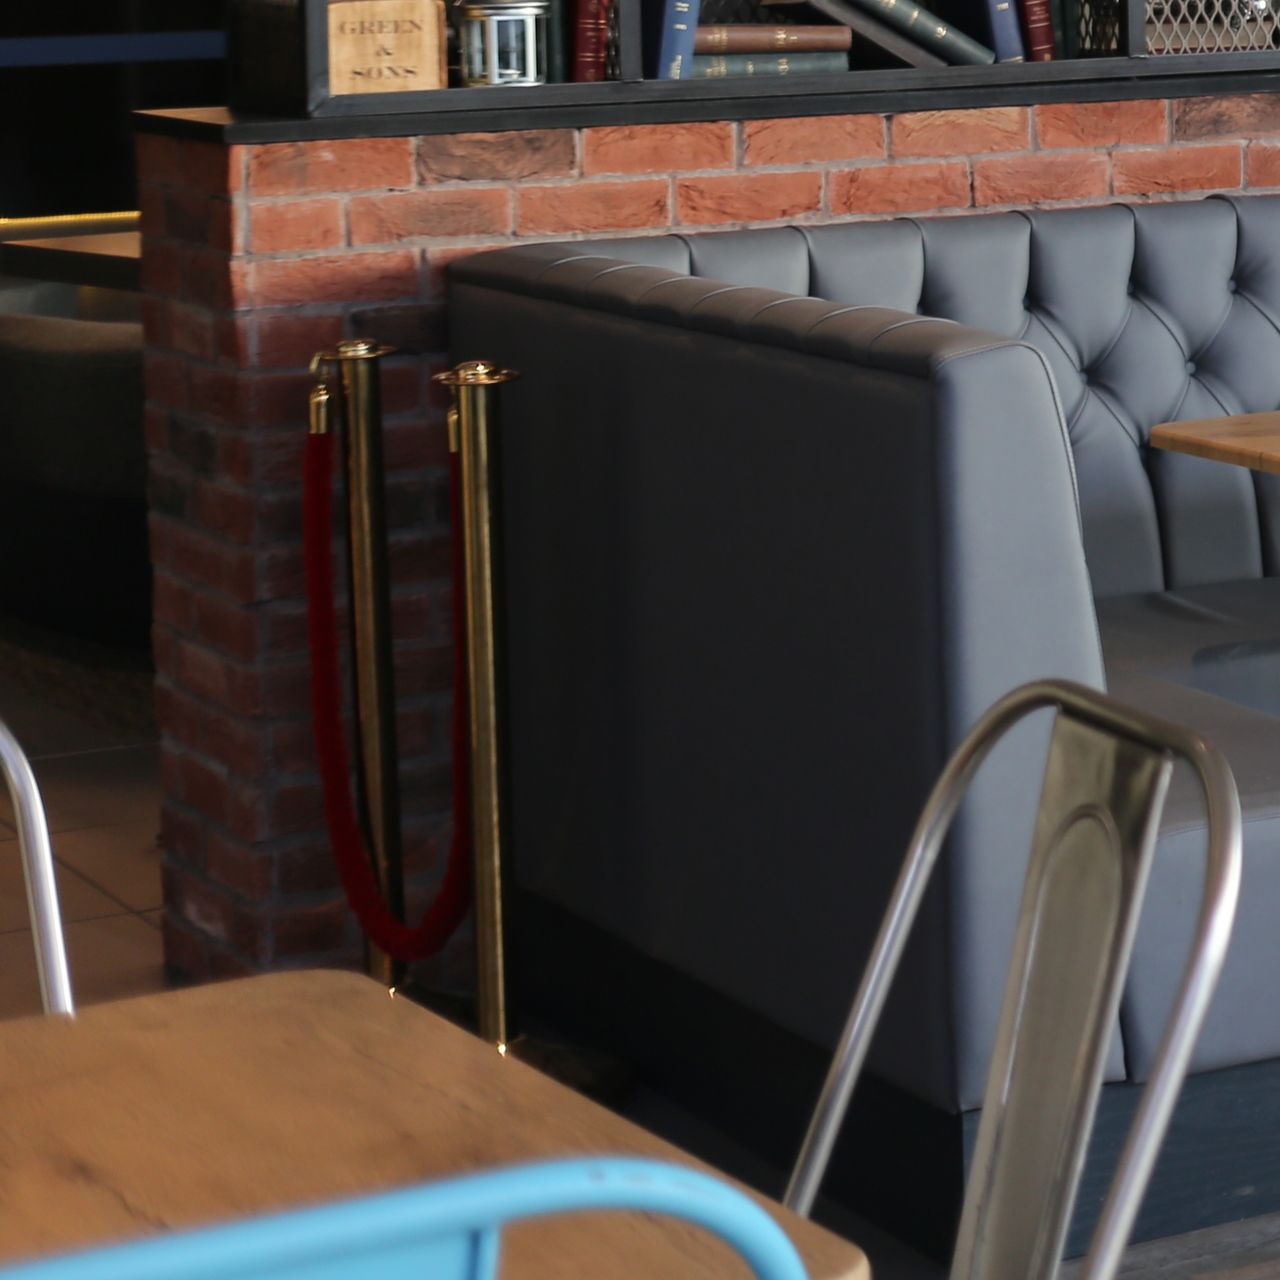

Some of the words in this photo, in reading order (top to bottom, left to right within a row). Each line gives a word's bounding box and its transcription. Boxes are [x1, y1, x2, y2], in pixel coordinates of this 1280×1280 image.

[338, 19, 424, 35] GREEN
[375, 44, 394, 57] &
[349, 65, 418, 81] SONS
